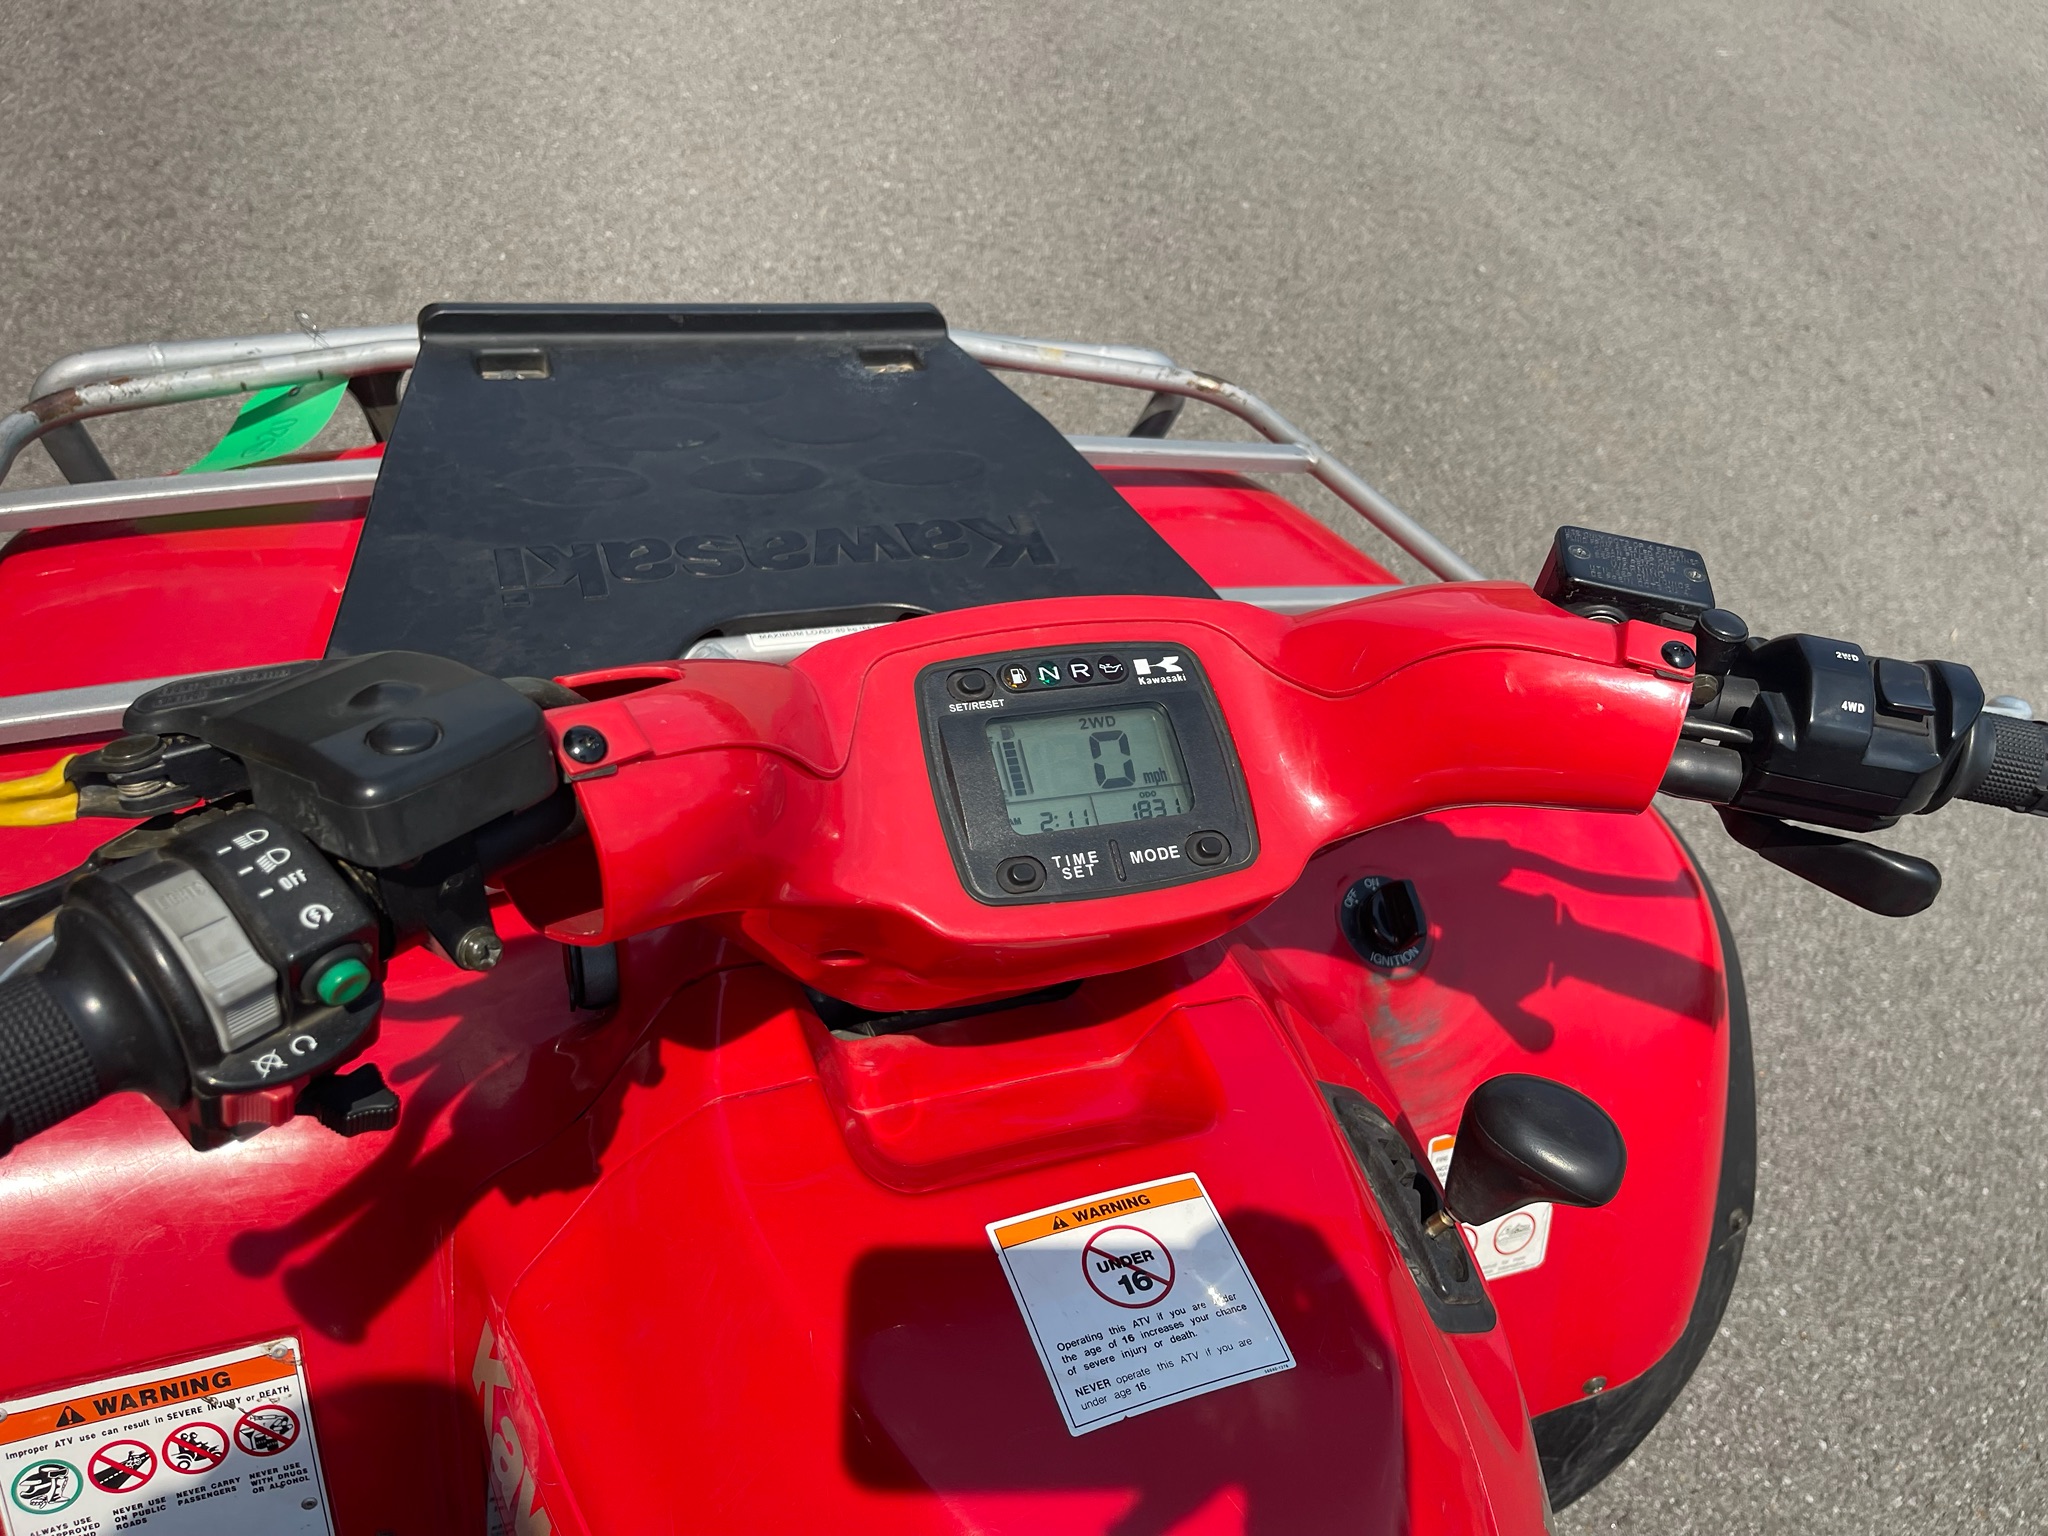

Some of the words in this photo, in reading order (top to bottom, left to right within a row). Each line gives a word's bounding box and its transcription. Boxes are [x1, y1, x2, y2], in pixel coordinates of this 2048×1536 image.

[493, 514, 1059, 607] Kawasaki
[759, 632, 804, 640] MAXIMUM
[806, 628, 833, 636] LOAD:
[1835, 651, 1860, 662] 2WD
[1038, 666, 1060, 682] N
[1070, 663, 1090, 678] R
[1138, 674, 1187, 686] Kawasaki
[949, 699, 1005, 713] SET/RESET
[1841, 700, 1865, 714] 4WD
[1078, 716, 1116, 730] 2WD
[1088, 730, 1136, 790] 0
[1142, 768, 1168, 786] mph
[1139, 790, 1157, 799] ODO
[1040, 809, 1090, 832] 2:11
[1052, 850, 1099, 868] TIME
[1130, 845, 1181, 865] MODE
[278, 869, 308, 891] OFF
[1062, 863, 1095, 880] SET
[1344, 888, 1358, 908] OFF
[1370, 946, 1420, 966] IGNITION
[1072, 1194, 1152, 1222] WARNING
[1096, 1250, 1156, 1274] UNDER
[1118, 1270, 1154, 1296] 16
[1056, 1332, 1104, 1352] Operating
[1108, 1324, 1126, 1336] this
[1132, 1316, 1150, 1328] ATV
[1156, 1312, 1164, 1321] if
[1169, 1307, 1187, 1320] you
[1192, 1302, 1206, 1312] are
[1062, 1352, 1078, 1364] the
[1084, 1344, 1102, 1358] age
[1108, 1338, 1118, 1349] of
[1122, 1334, 1136, 1344] 16
[1140, 1320, 1184, 1339] increases
[1190, 1314, 1210, 1326] your
[1216, 1304, 1248, 1318] chance
[1067, 1366, 1077, 1376] of
[1084, 1355, 1116, 1372] severe
[1121, 1345, 1148, 1360] injury
[1154, 1340, 1164, 1349] or
[1170, 1330, 1198, 1344] death.
[1074, 1379, 1112, 1398] NEVER
[1116, 1368, 1151, 1384] operate
[1157, 1358, 1175, 1371] this
[1180, 1352, 1200, 1364] ATV
[1205, 1348, 1212, 1356] if
[1217, 1344, 1234, 1356] you
[1238, 1338, 1253, 1348] are
[93, 1371, 232, 1416] WARNING
[1081, 1395, 1108, 1411] under
[1114, 1386, 1132, 1400] age
[5, 1443, 48, 1460] Improper
[54, 1437, 74, 1448] ATV
[79, 1433, 97, 1442] use
[101, 1427, 119, 1437] can
[124, 1418, 150, 1432] result
[154, 1416, 164, 1424] in
[167, 1406, 204, 1422] SEVERE
[207, 1396, 242, 1412] INJURY
[246, 1394, 256, 1402] or
[260, 1384, 290, 1400] DEATH
[248, 1468, 279, 1480] NEVER
[283, 1462, 300, 1471] USE
[250, 1476, 274, 1487] WITH
[277, 1468, 308, 1480] DRUGS
[176, 1486, 207, 1499] NEVER
[210, 1476, 241, 1490] CARRY
[178, 1486, 238, 1506] PASSENGERS
[252, 1486, 266, 1494] OR
[113, 1502, 144, 1516] NEVER
[148, 1496, 167, 1507] USE
[114, 1514, 128, 1523] ON
[132, 1504, 168, 1519] PUBLIC
[73, 1516, 92, 1526] USE
[116, 1518, 148, 1531] ROADS
